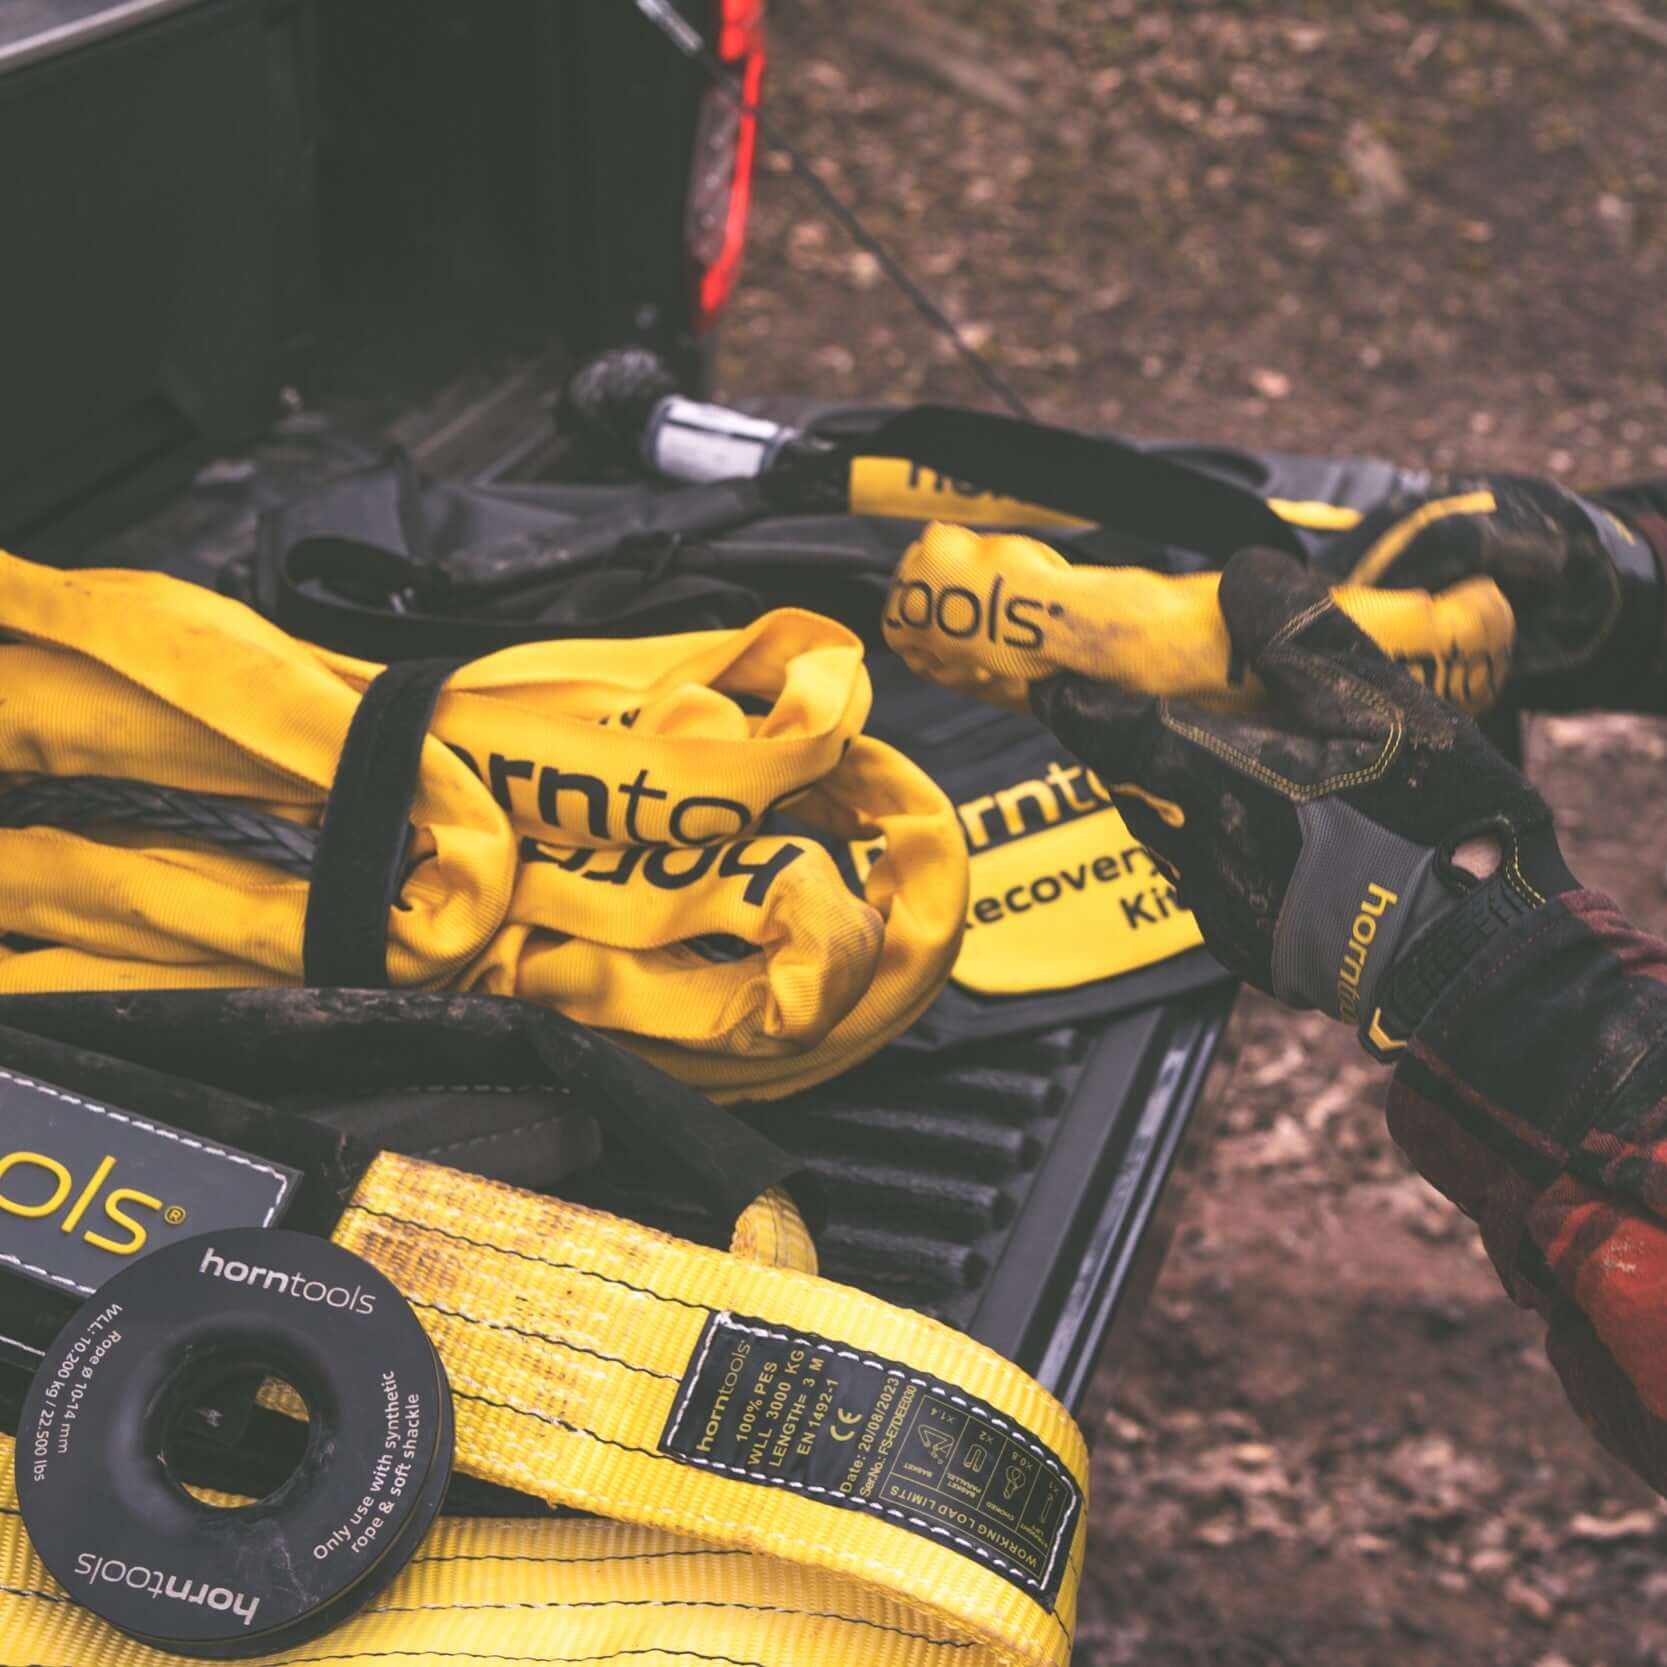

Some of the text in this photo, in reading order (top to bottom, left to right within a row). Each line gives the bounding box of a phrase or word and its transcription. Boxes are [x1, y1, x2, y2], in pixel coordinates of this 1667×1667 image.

[199, 1247, 377, 1314] horntools
[87, 1303, 123, 1335] WLL:
[57, 1336, 91, 1379] 10.200
[89, 1330, 122, 1364] Rope
[45, 1381, 65, 1398] kg
[64, 1383, 87, 1419] 10-14
[735, 1361, 778, 1442] 100% PES
[747, 1349, 805, 1465] WLL 3000 KG
[769, 1357, 825, 1467] LENGTH= 3 M
[34, 1410, 54, 1456] 22.500
[57, 1423, 71, 1453] mm
[796, 1379, 839, 1456] EN 1492-1
[840, 1377, 900, 1493] Date: 20/08/2023
[33, 1459, 47, 1482] lbs
[313, 1370, 401, 1560] Only use with synthetic
[351, 1393, 419, 1552] rope & soft shackle
[889, 1485, 936, 1511] LIMITS
[938, 1504, 976, 1528] LOAD
[978, 1522, 1037, 1568] WORKING
[74, 1552, 261, 1626] horntools
